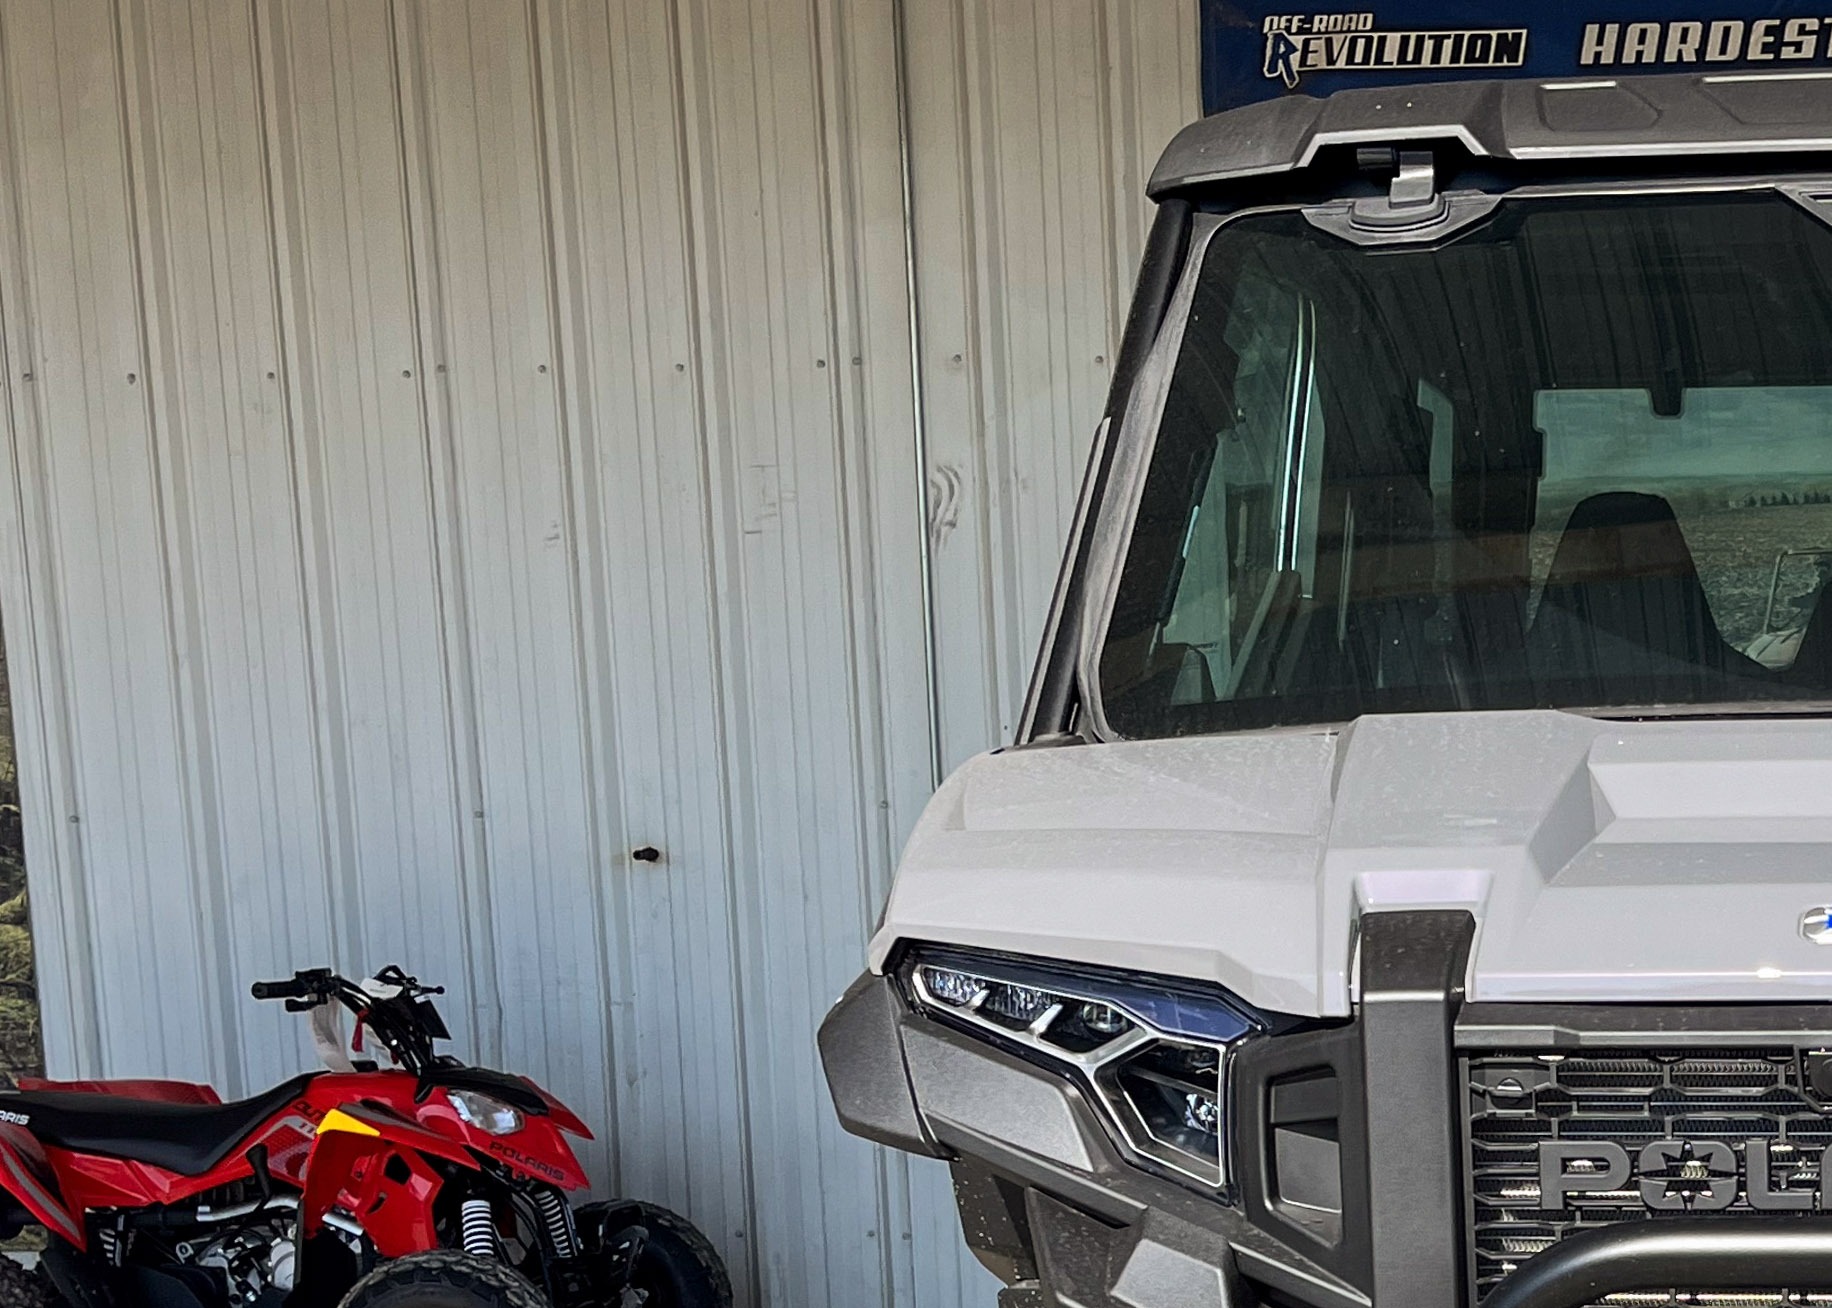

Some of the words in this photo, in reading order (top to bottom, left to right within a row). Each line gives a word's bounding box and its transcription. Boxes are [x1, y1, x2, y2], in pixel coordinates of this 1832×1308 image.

[1263, 13, 1373, 33] OFF-ROAD
[1263, 29, 1528, 89] REVOLUTION
[489, 1141, 565, 1180] POLARIS
